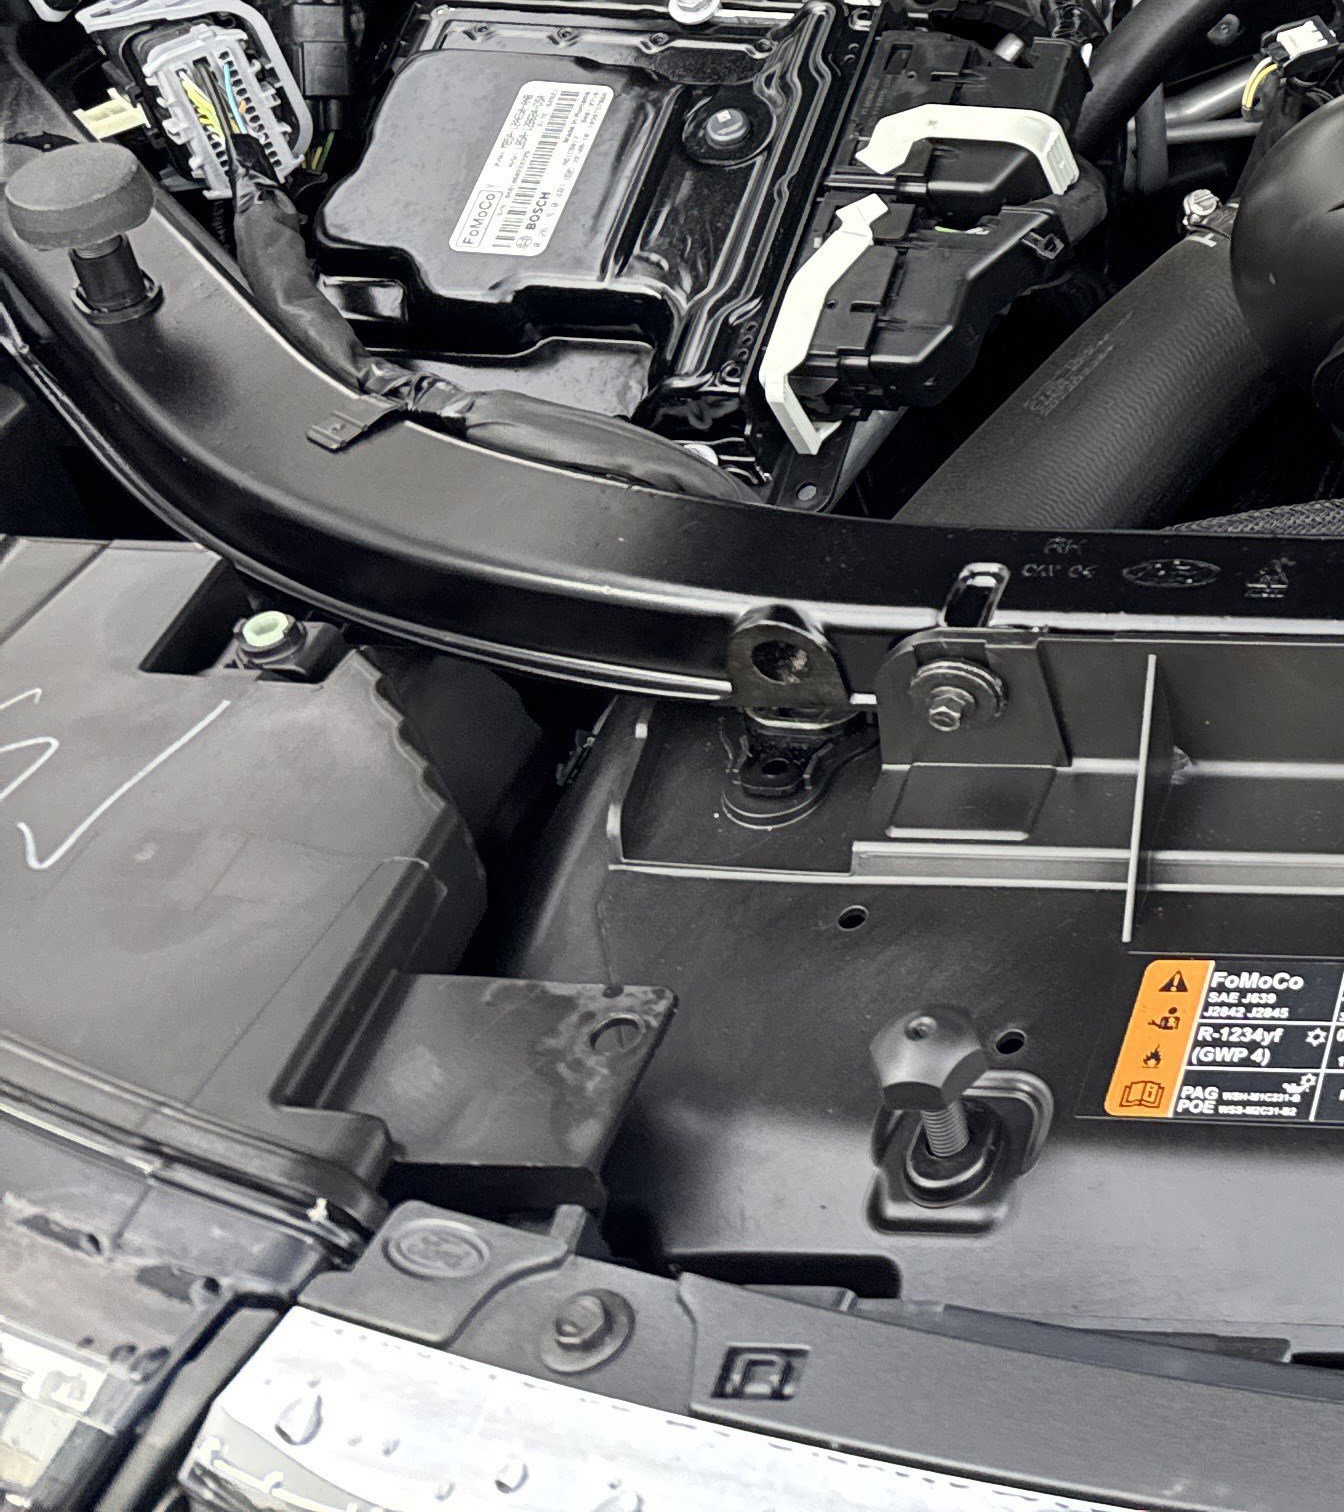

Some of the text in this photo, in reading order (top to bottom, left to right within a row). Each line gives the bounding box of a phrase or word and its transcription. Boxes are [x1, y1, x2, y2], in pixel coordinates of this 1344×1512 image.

[462, 193, 496, 245] FoMoCo
[525, 191, 551, 230] BOSCH
[1210, 971, 1304, 990] FoMoCo
[1207, 992, 1277, 1004] SAE J639
[1202, 1006, 1290, 1019] J2842 J2845
[1197, 1026, 1285, 1046] R-1234yf
[1191, 1047, 1271, 1067] (GWP 4)
[1181, 1086, 1219, 1100] PAG
[1176, 1099, 1217, 1114] POE
